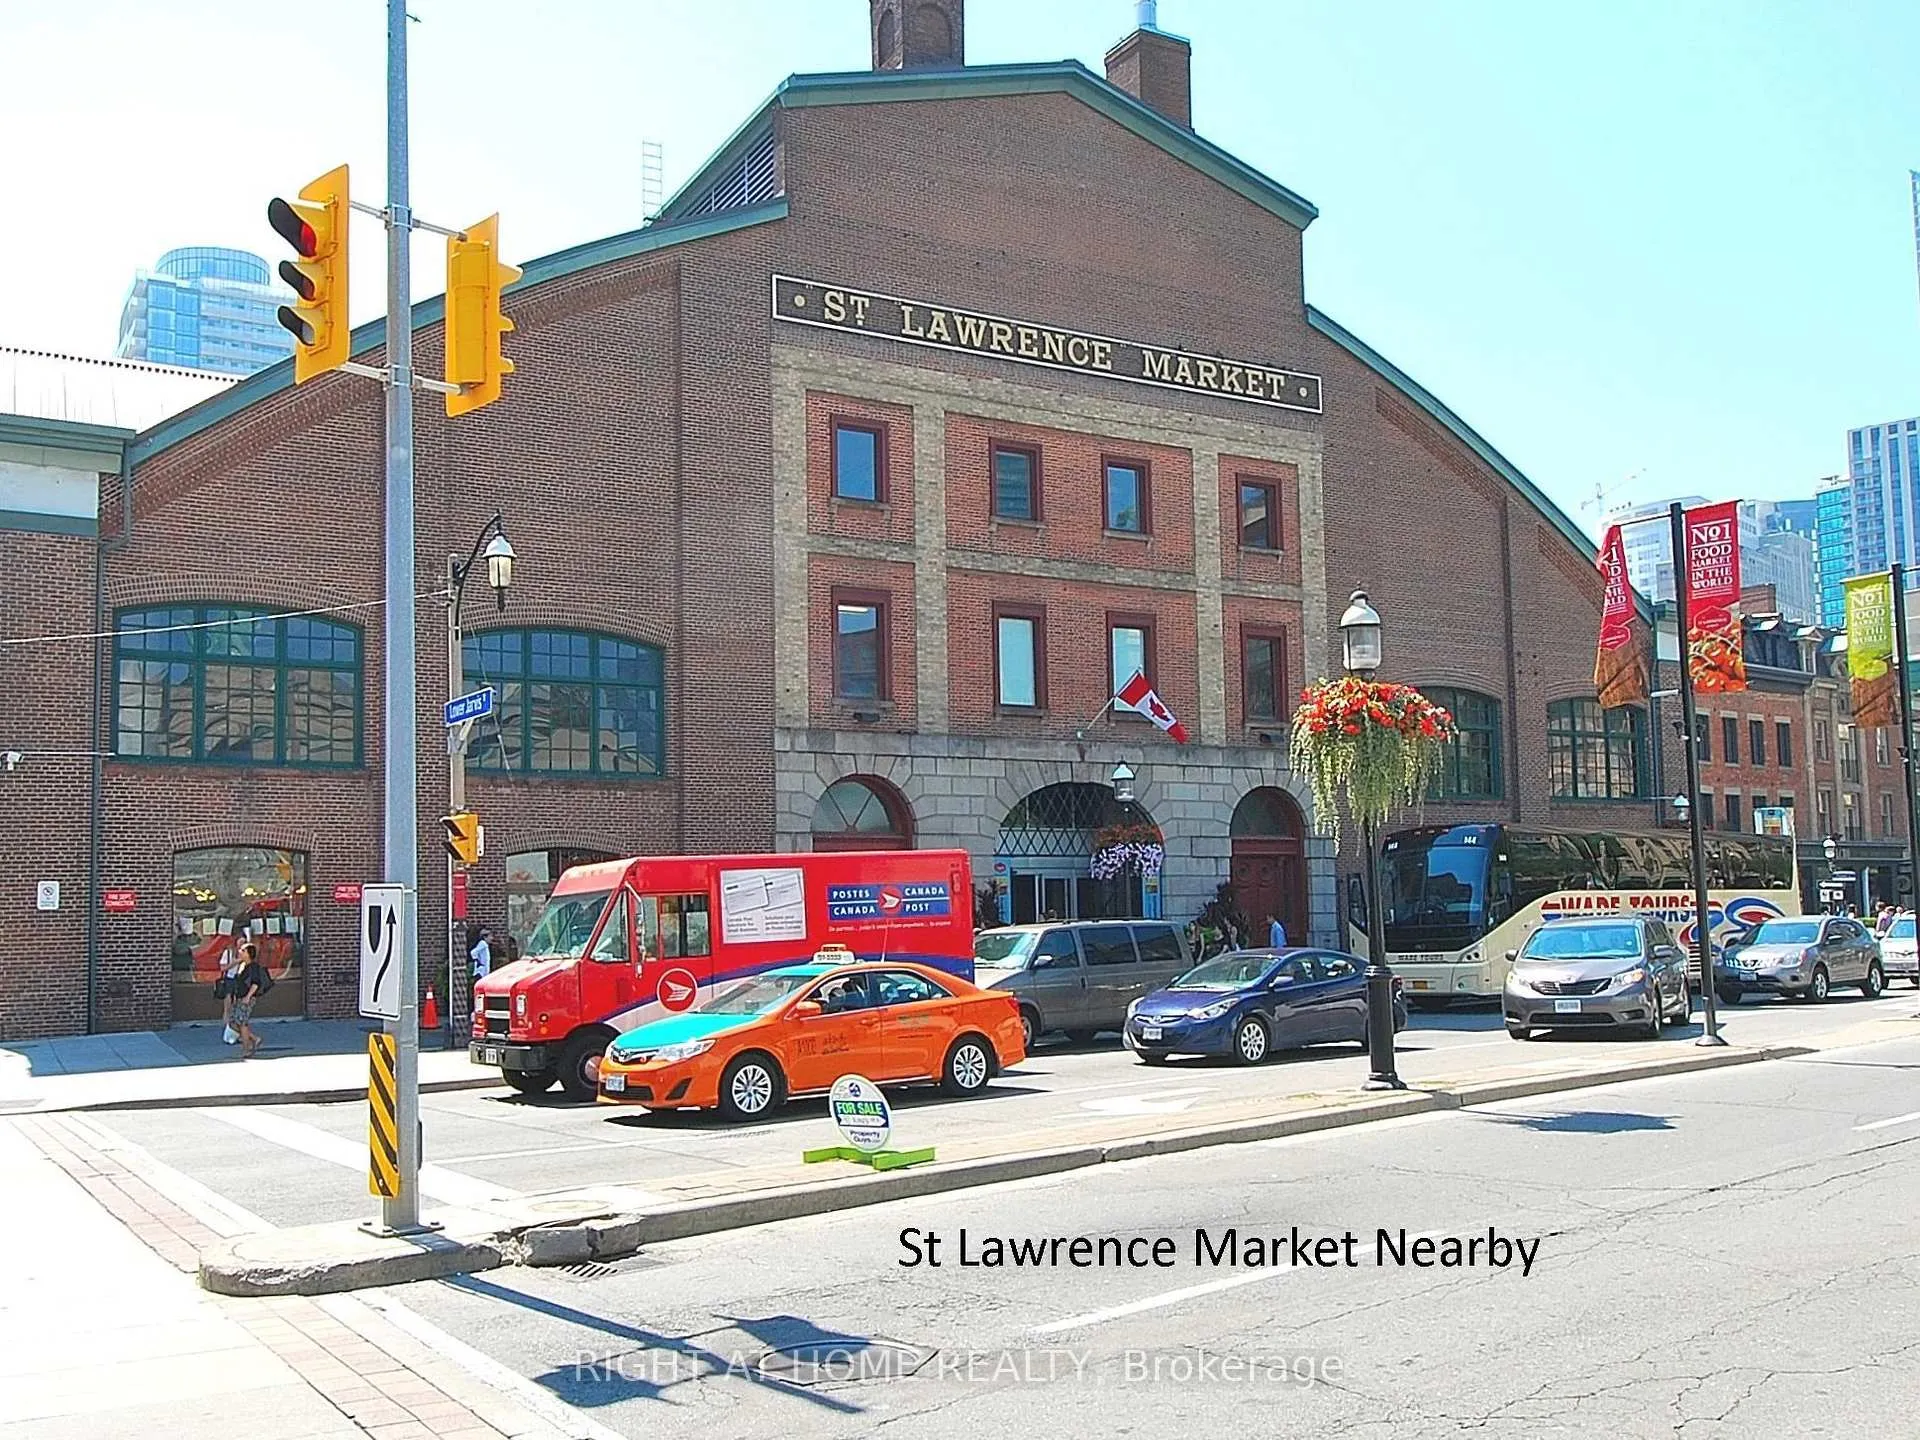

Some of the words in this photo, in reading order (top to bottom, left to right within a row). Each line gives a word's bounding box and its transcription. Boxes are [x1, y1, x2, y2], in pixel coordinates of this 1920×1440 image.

[900, 304, 1113, 371] LAWRENCE
[1142, 350, 1286, 400] MARKET
[1692, 544, 1732, 560] FOOD
[1692, 555, 1731, 568] MARKET
[1692, 571, 1704, 580] IN
[1708, 566, 1732, 578] THE
[1692, 577, 1733, 589] WORLD
[465, 694, 483, 714] Jarvis
[833, 889, 870, 899] POSTES
[904, 886, 945, 896] CANADA
[833, 905, 876, 916] CANADA
[905, 902, 930, 912] POST
[1560, 896, 1621, 917] WADE
[1629, 895, 1691, 923] TOURS
[836, 1101, 857, 1114] FOR
[857, 1101, 883, 1115] SALE
